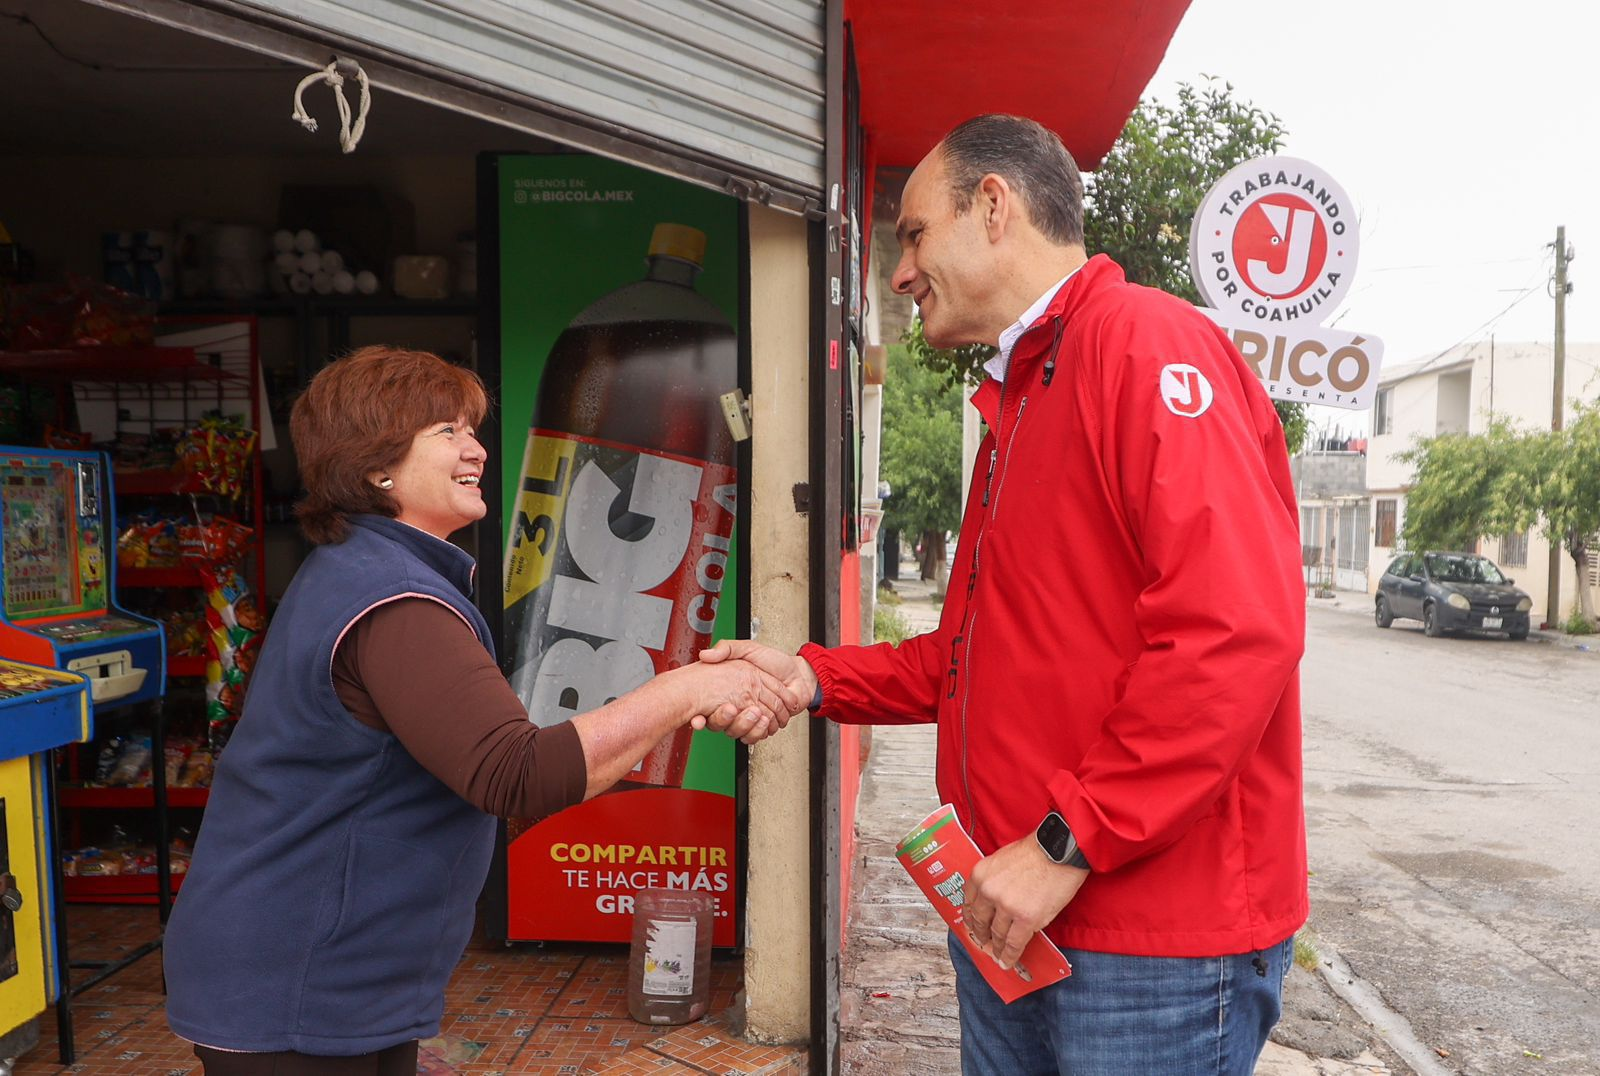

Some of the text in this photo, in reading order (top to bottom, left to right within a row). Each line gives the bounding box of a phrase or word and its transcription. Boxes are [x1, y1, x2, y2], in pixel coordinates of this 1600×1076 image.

[532, 190, 634, 202] @BIGCOLA.MEX
[1219, 170, 1346, 236] TRABAJANDO
[1211, 250, 1342, 322] POR COAHUILA
[1222, 328, 1370, 392] RICÓ
[1269, 384, 1358, 405] ESENTA
[550, 842, 728, 867] COMPARTIR
[562, 867, 728, 892] TE HACE MÁS
